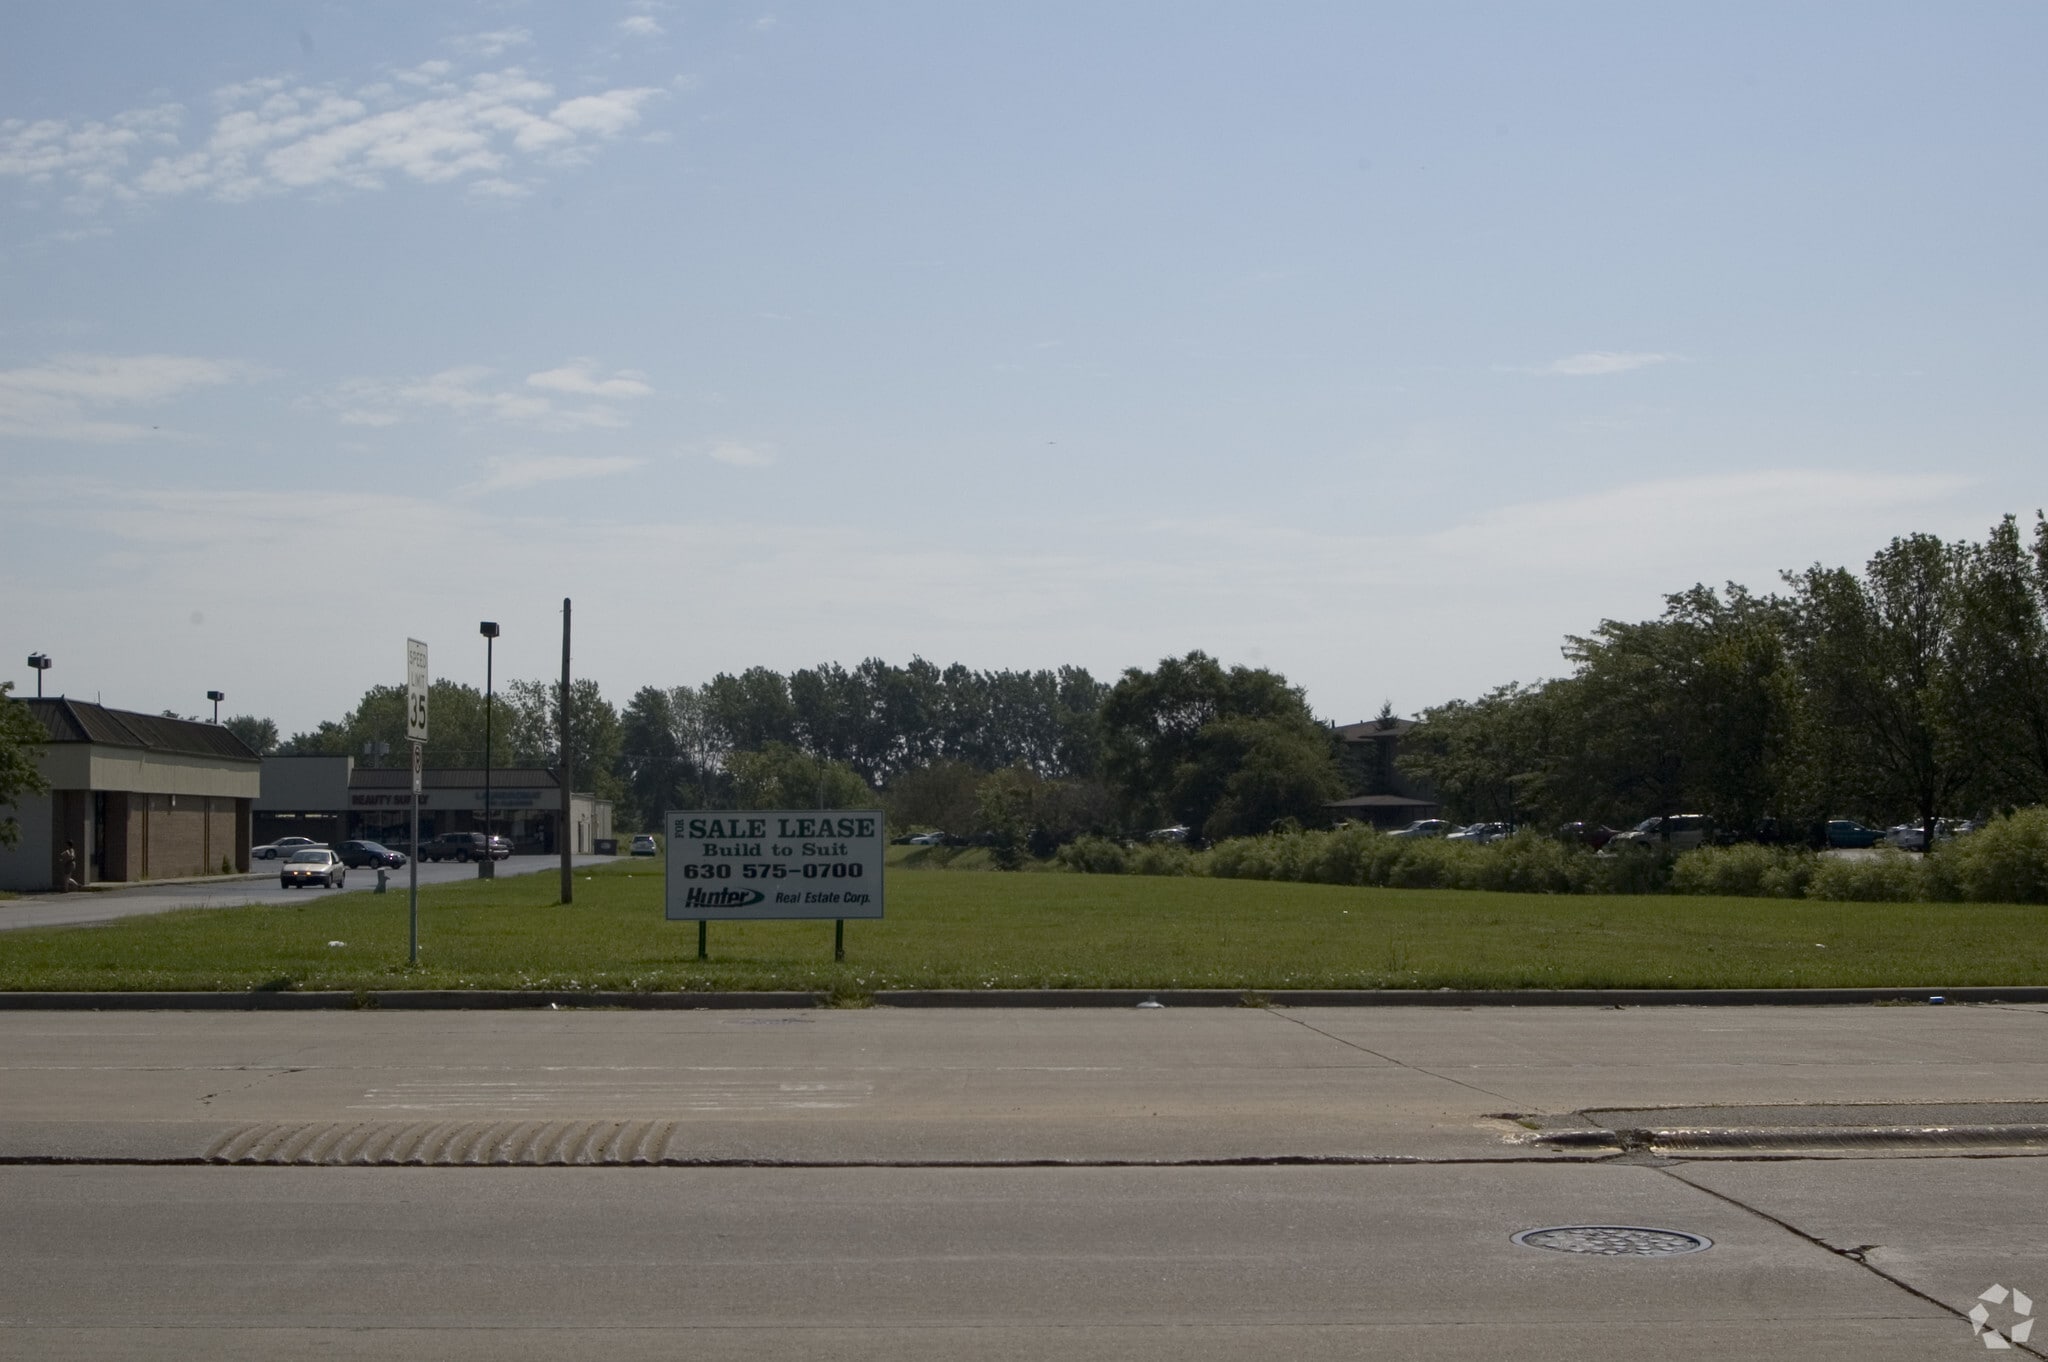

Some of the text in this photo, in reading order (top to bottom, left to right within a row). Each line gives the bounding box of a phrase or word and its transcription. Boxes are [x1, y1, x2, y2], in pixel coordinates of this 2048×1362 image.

[409, 650, 426, 668] SPEED
[411, 672, 425, 689] LIMIT
[410, 692, 426, 729] 35
[352, 794, 429, 805] BEAUTY SUPLY
[675, 819, 684, 838] FOR
[689, 818, 875, 838] SALE LEASE
[703, 842, 848, 856] Build to Suit
[684, 862, 863, 879] 630 575-0700
[685, 887, 752, 908] Hunter
[776, 891, 871, 905] Real Estate Corp.
